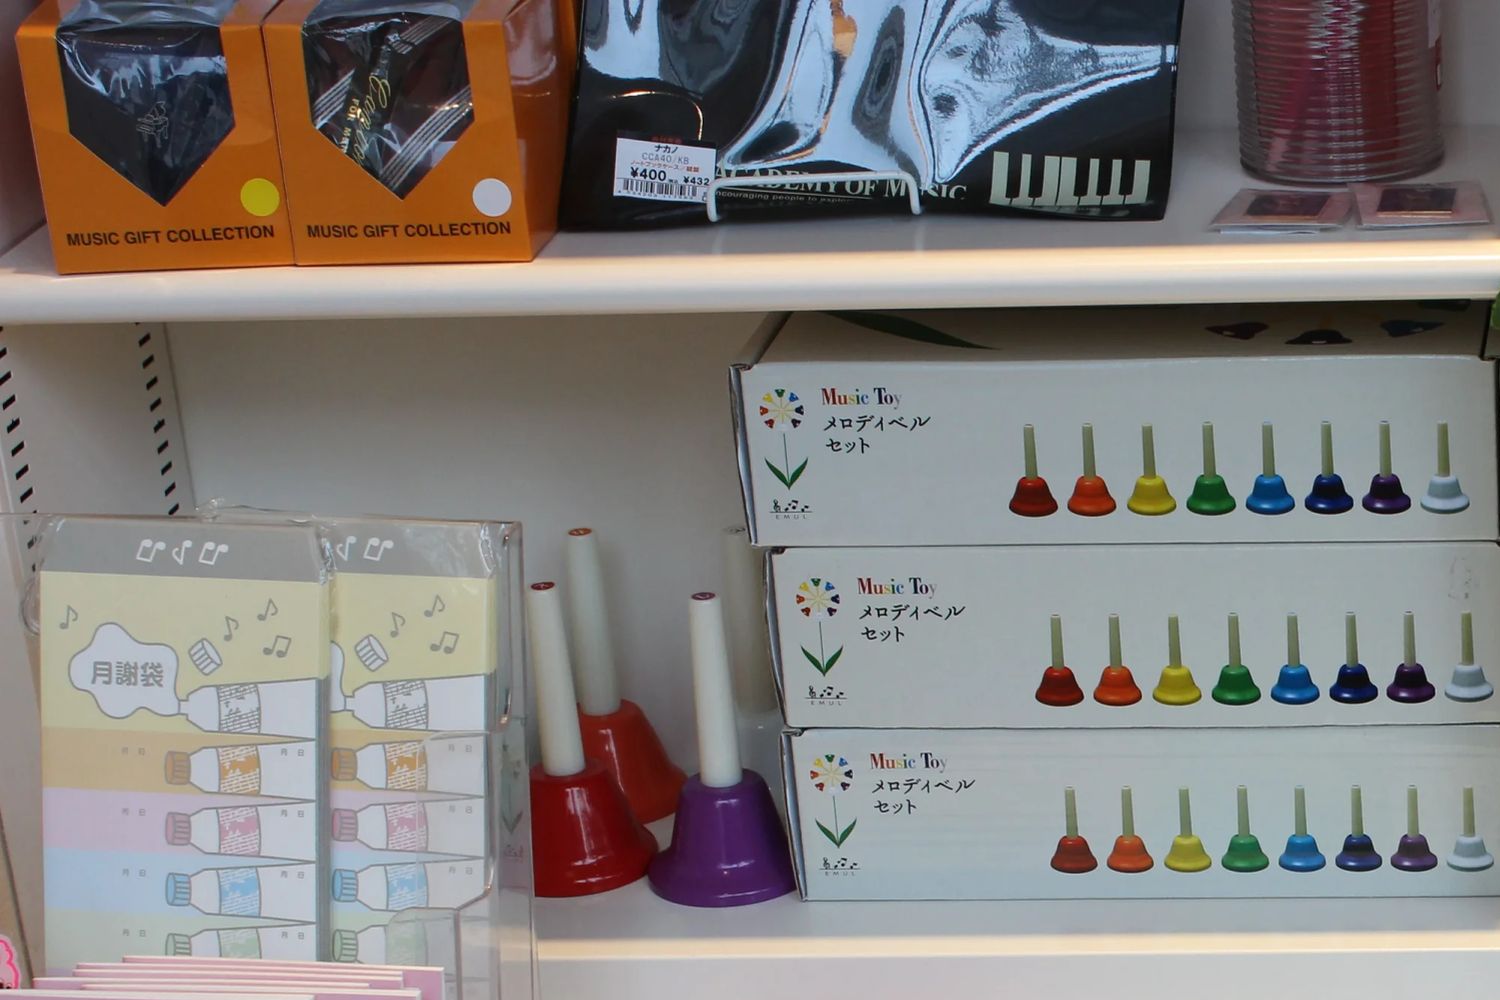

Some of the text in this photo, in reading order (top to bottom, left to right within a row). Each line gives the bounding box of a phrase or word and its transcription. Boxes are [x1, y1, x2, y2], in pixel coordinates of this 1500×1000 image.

[654, 144, 679, 155] ナカノ
[630, 166, 667, 182] ¥400
[683, 175, 710, 186] ¥432
[715, 190, 769, 201] ncouraging
[846, 180, 879, 197] OF
[885, 180, 969, 200] MSIC
[67, 224, 275, 247] MUSIC GIFT COLLECTION
[307, 220, 512, 239] MUSIC GIFT COLLECTION
[821, 387, 902, 409] Music Toy
[823, 415, 931, 432] メロディベル
[826, 437, 870, 454] セット
[857, 577, 937, 599] Music Toy
[858, 604, 966, 621] メロディベル
[861, 625, 905, 643] セット
[91, 661, 164, 688] 月謝袋
[870, 752, 948, 773] Music Toy
[872, 779, 976, 795] メロディベル
[874, 798, 917, 815] セット
